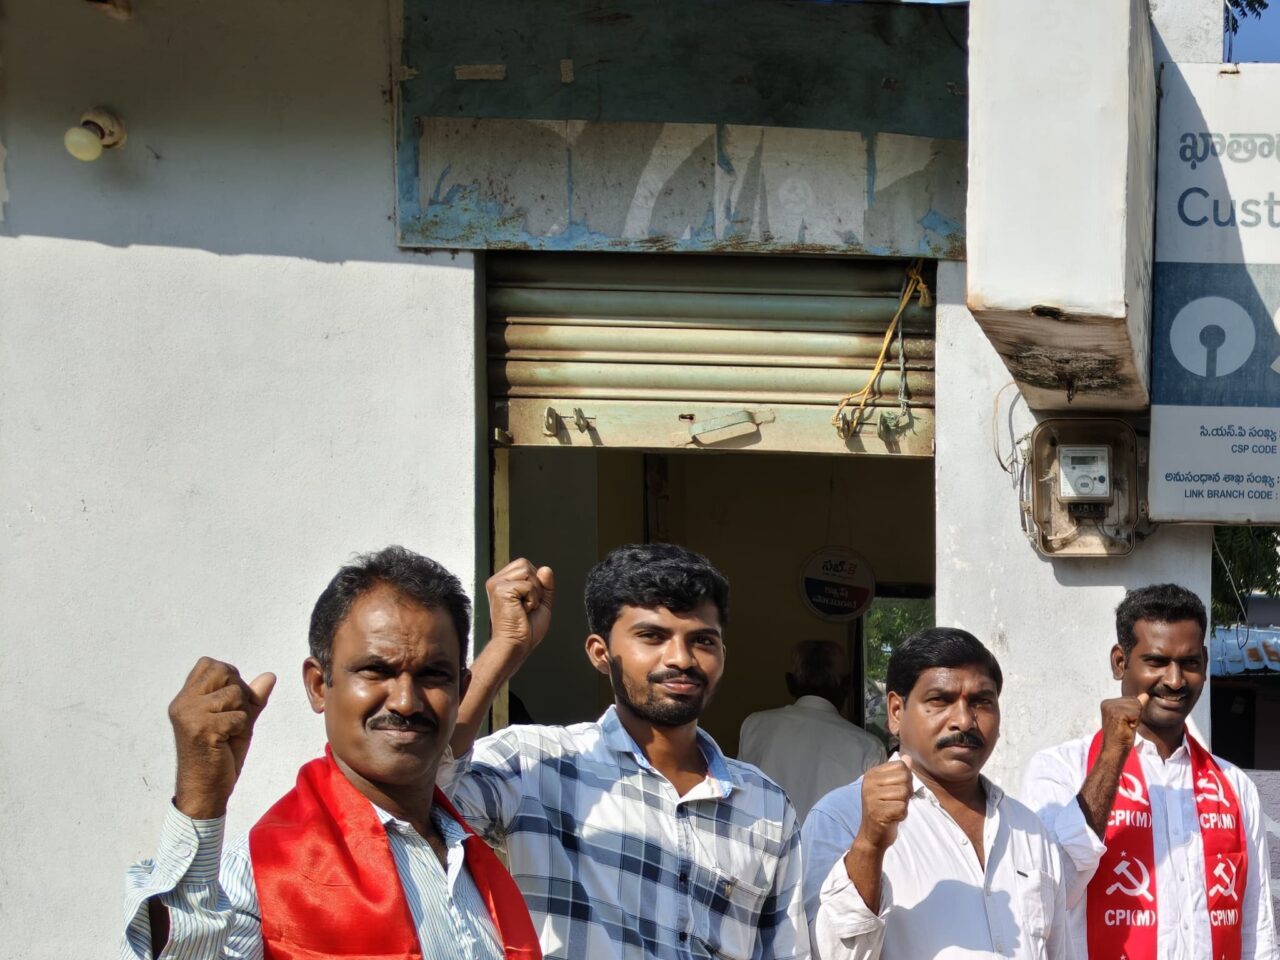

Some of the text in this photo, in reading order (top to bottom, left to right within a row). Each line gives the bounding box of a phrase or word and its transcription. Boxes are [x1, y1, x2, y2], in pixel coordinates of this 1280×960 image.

[1231, 445, 1249, 454] CSP
[1252, 445, 1277, 454] CODE
[1184, 489, 1204, 498] LINK
[1207, 489, 1245, 499] BRANCH
[1247, 490, 1273, 500] CODE
[1107, 809, 1152, 828] CPI(M)
[1200, 812, 1236, 830] CPI(M)
[1104, 908, 1156, 927] CPI(M)
[1210, 908, 1238, 927] CPI(M)
